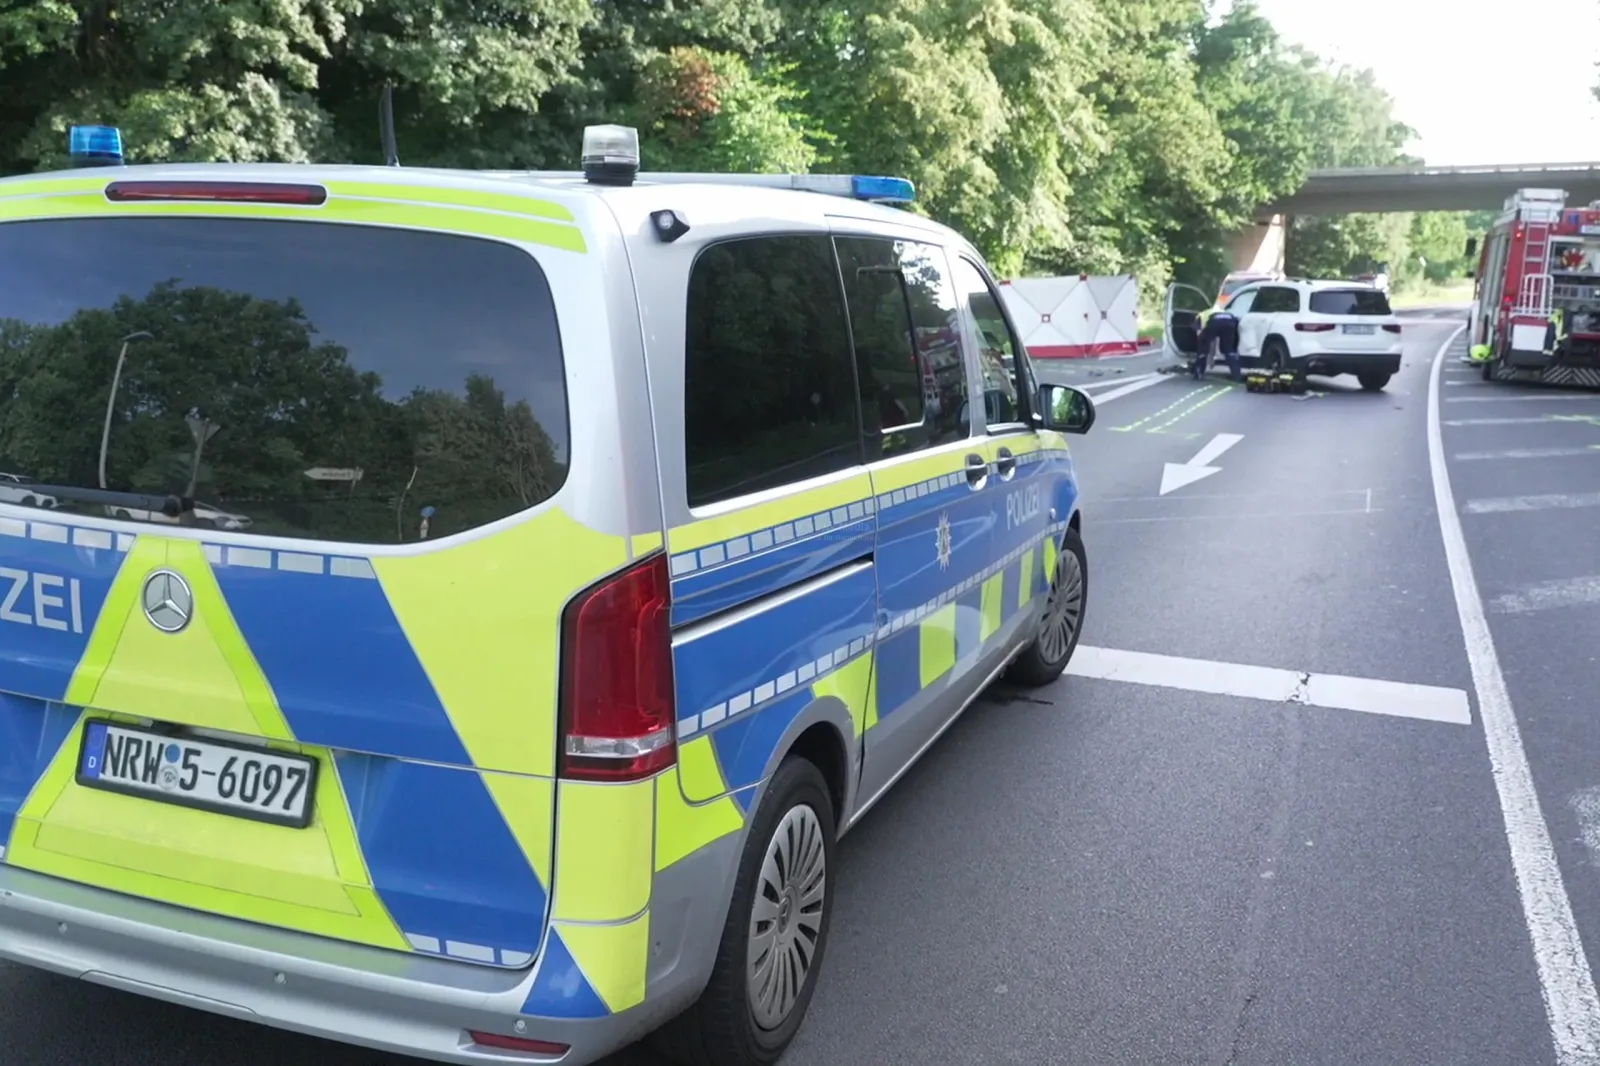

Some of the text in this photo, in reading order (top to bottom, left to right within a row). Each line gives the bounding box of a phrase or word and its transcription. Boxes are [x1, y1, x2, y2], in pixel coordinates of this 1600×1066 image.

[1006, 483, 1040, 530] POLIZEI
[0, 566, 84, 635] ZEI
[88, 755, 96, 769] D
[101, 732, 165, 786] NRW
[179, 748, 307, 811] 5-6097
